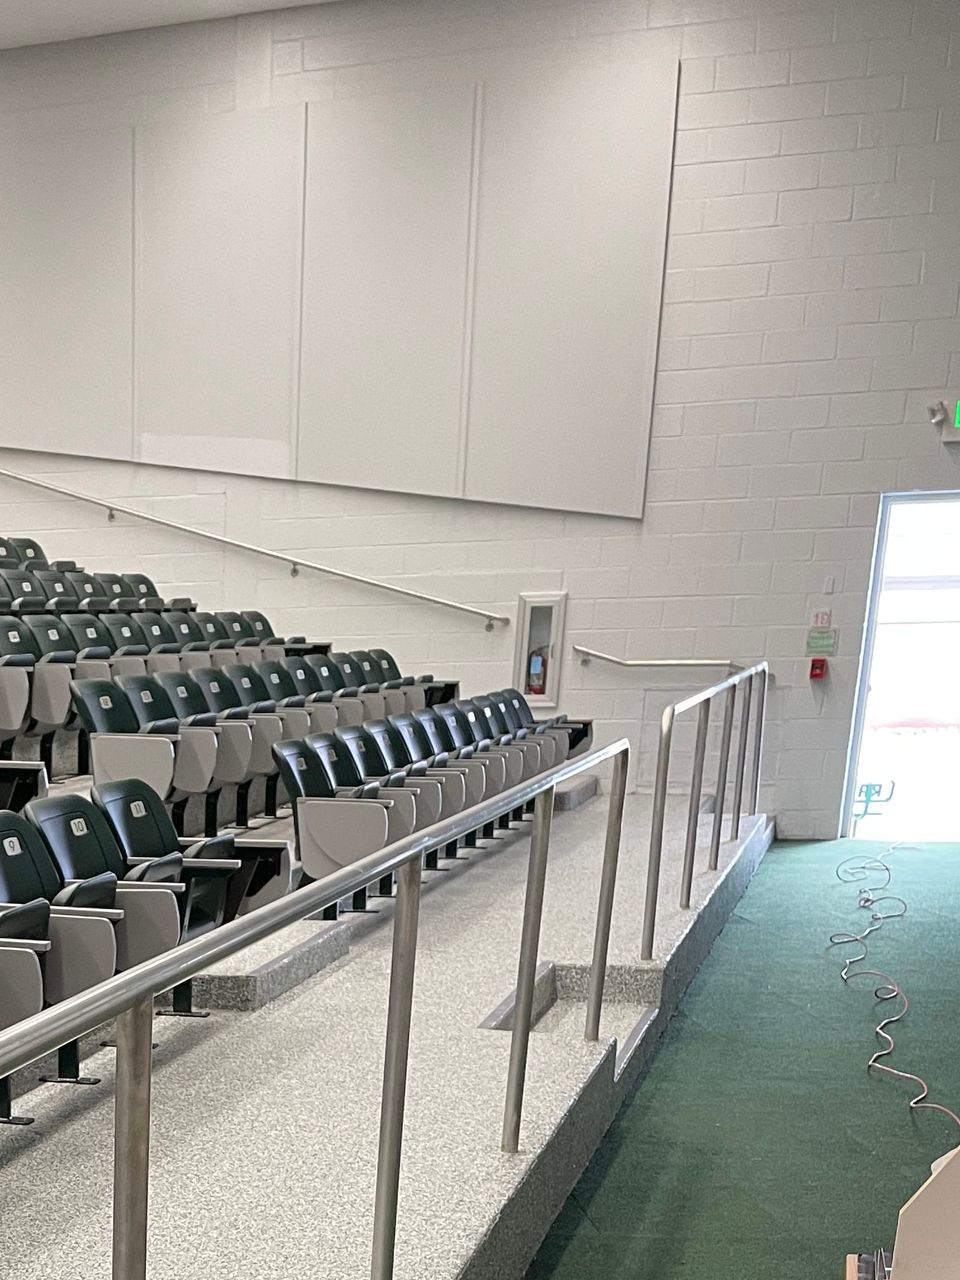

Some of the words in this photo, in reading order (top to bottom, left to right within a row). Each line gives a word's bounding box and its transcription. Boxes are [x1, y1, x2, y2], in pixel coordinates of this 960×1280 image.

[133, 803, 143, 815] 11
[73, 820, 85, 833] 10
[8, 840, 15, 852] 9
